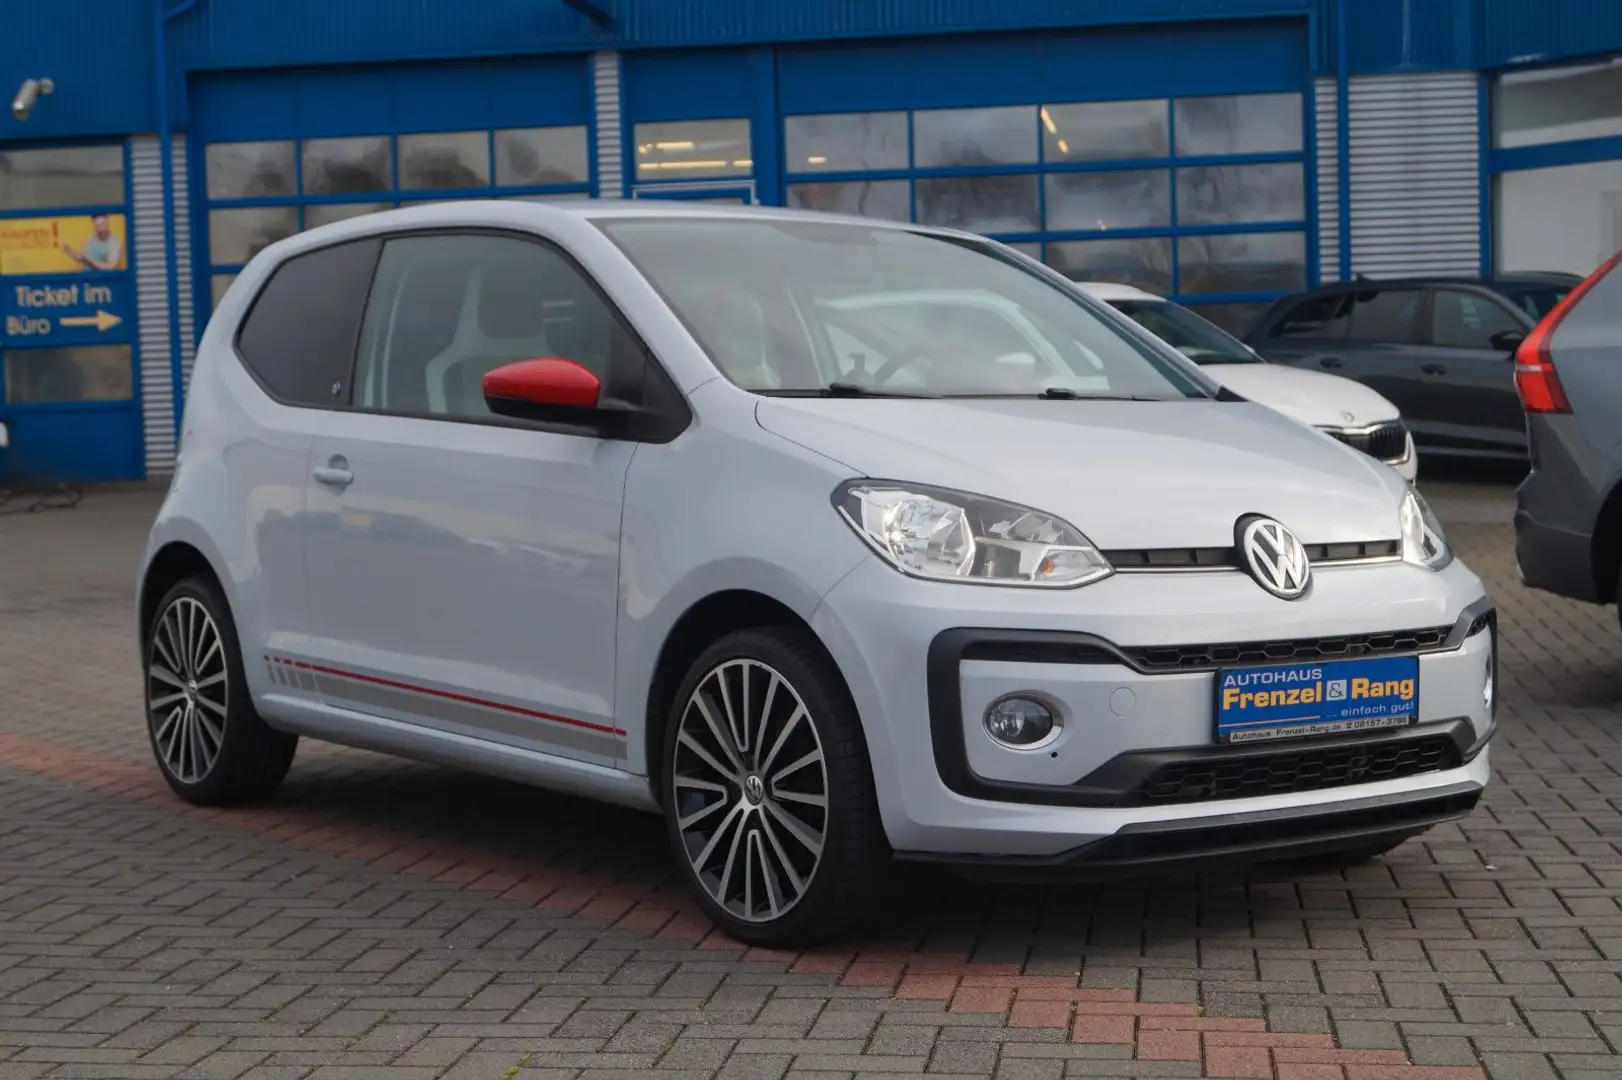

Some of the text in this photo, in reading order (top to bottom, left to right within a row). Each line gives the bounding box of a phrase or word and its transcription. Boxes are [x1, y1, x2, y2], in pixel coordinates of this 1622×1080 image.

[14, 283, 111, 308] Ticket im
[6, 315, 51, 336] Büro
[1244, 519, 1309, 598] VW
[1224, 668, 1322, 687] AUTOHAUS
[1223, 678, 1414, 710] Frenzel & Rang
[1341, 704, 1386, 716] einfach
[1390, 702, 1414, 713] gut!
[1232, 731, 1271, 740] Autohaus
